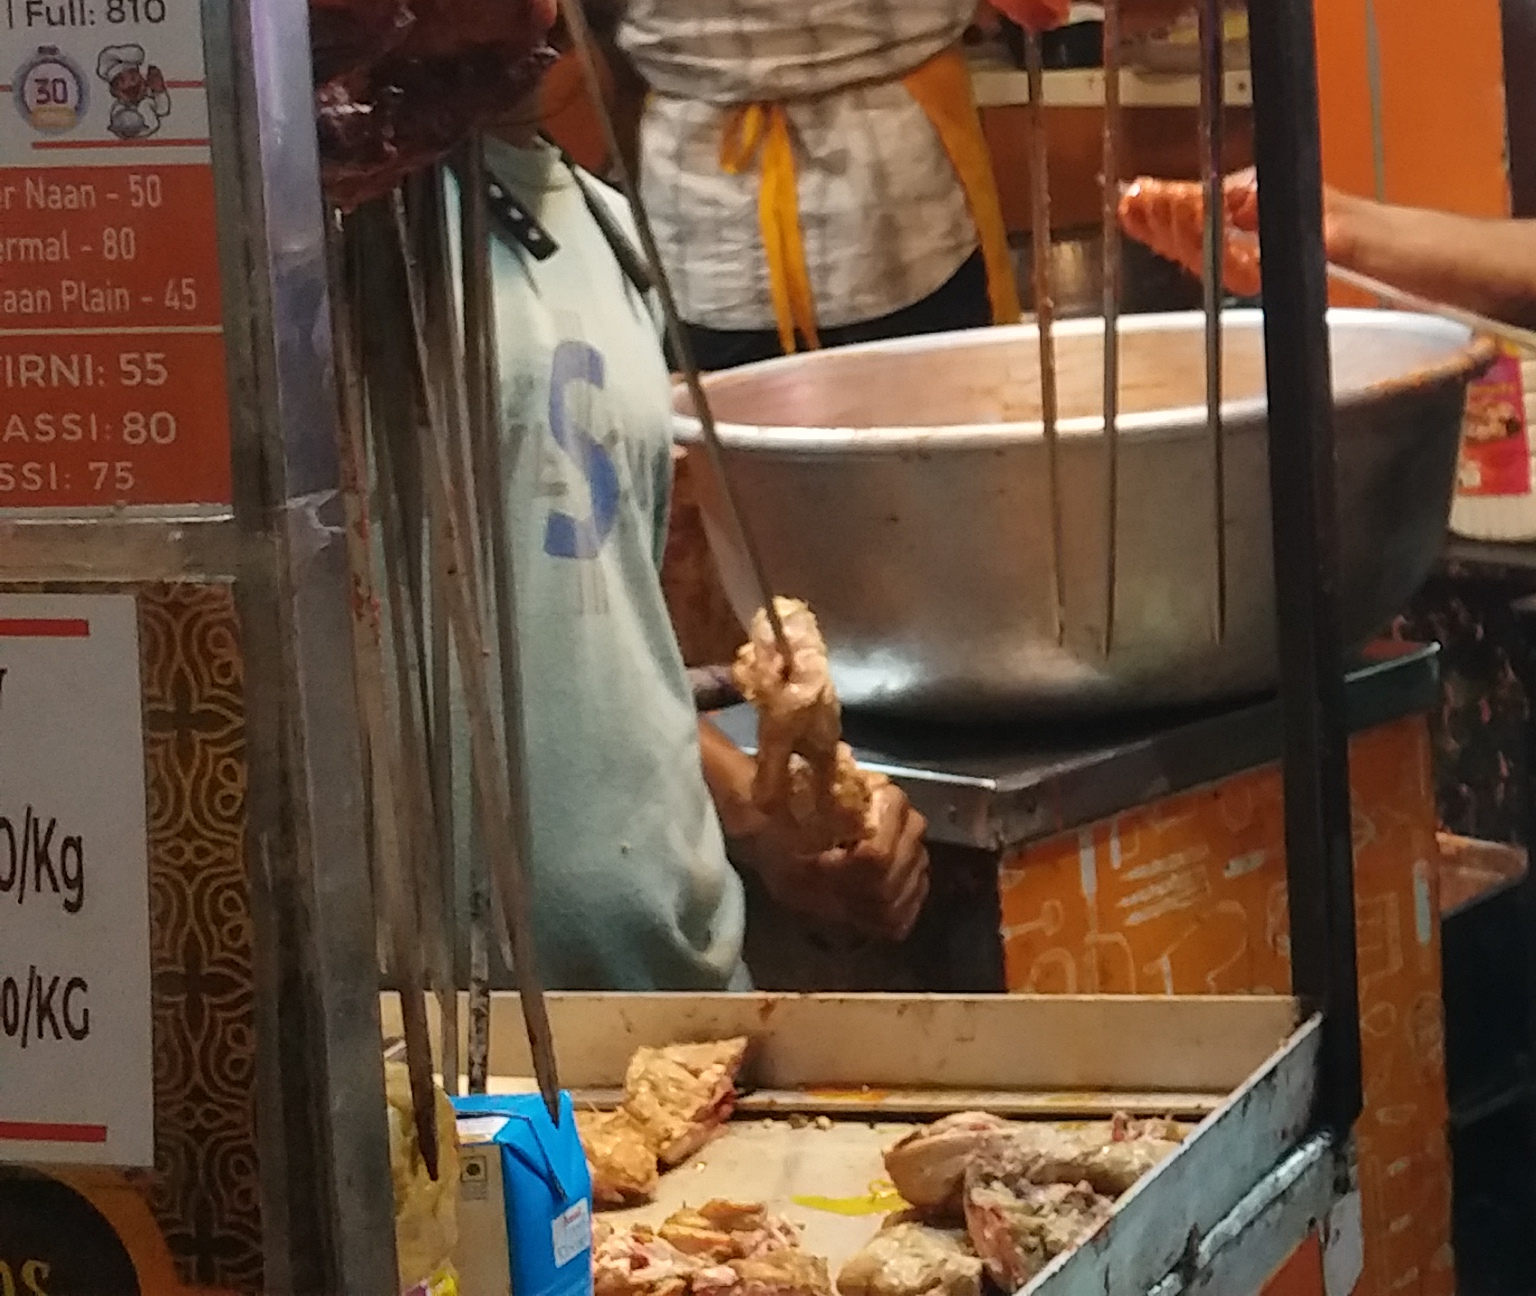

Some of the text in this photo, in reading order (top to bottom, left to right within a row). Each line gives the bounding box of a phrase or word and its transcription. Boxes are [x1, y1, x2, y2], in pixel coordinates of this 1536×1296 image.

[34, 78, 68, 104] 30
[25, 176, 96, 210] Naan
[128, 174, 162, 208] 50
[0, 228, 70, 261] rmal
[103, 226, 136, 261] 80
[61, 278, 130, 313] Plain
[164, 277, 197, 311] 45
[0, 351, 168, 388] IRNI: 55
[2, 410, 177, 445] ASSI: 80
[88, 460, 136, 491] 75
